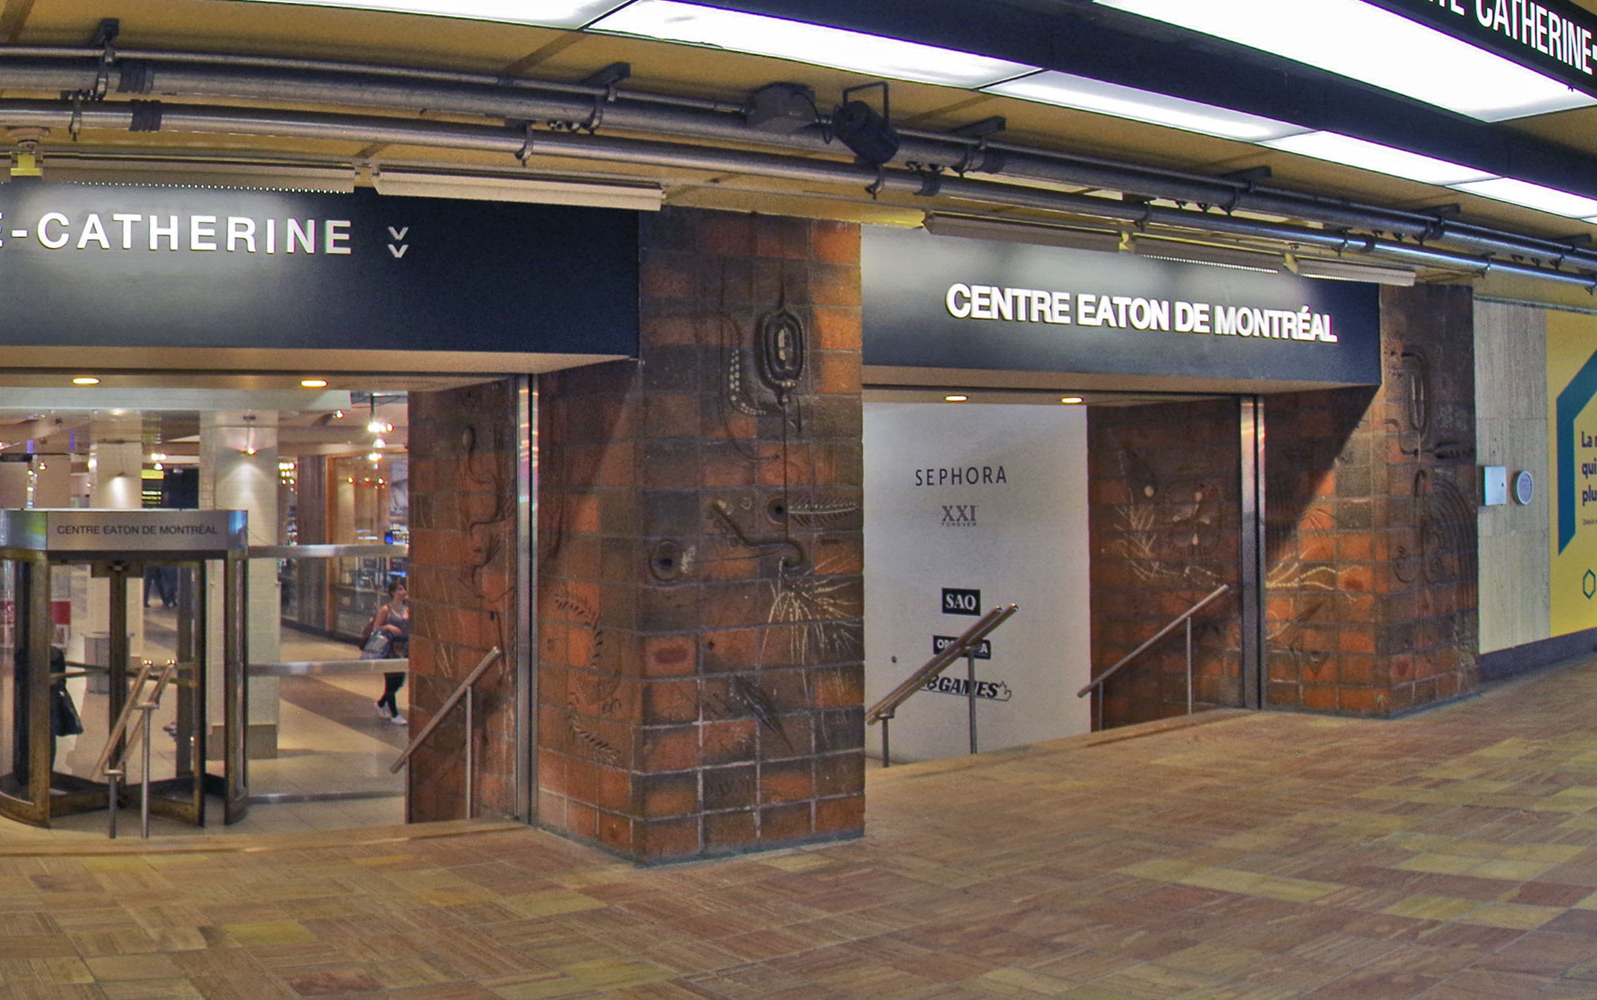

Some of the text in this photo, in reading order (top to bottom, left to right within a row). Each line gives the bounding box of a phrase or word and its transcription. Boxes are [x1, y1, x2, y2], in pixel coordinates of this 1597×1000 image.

[1475, 0, 1594, 76] CATHERINE
[945, 282, 1340, 343] CENTRE EATON DE MONTRÉAL
[1581, 431, 1593, 448] La
[915, 465, 1008, 487] SEPHORA
[941, 505, 977, 522] XXI
[56, 521, 219, 536] CENTRE EATON DE MONTRÉAL
[945, 593, 977, 611] SAQ
